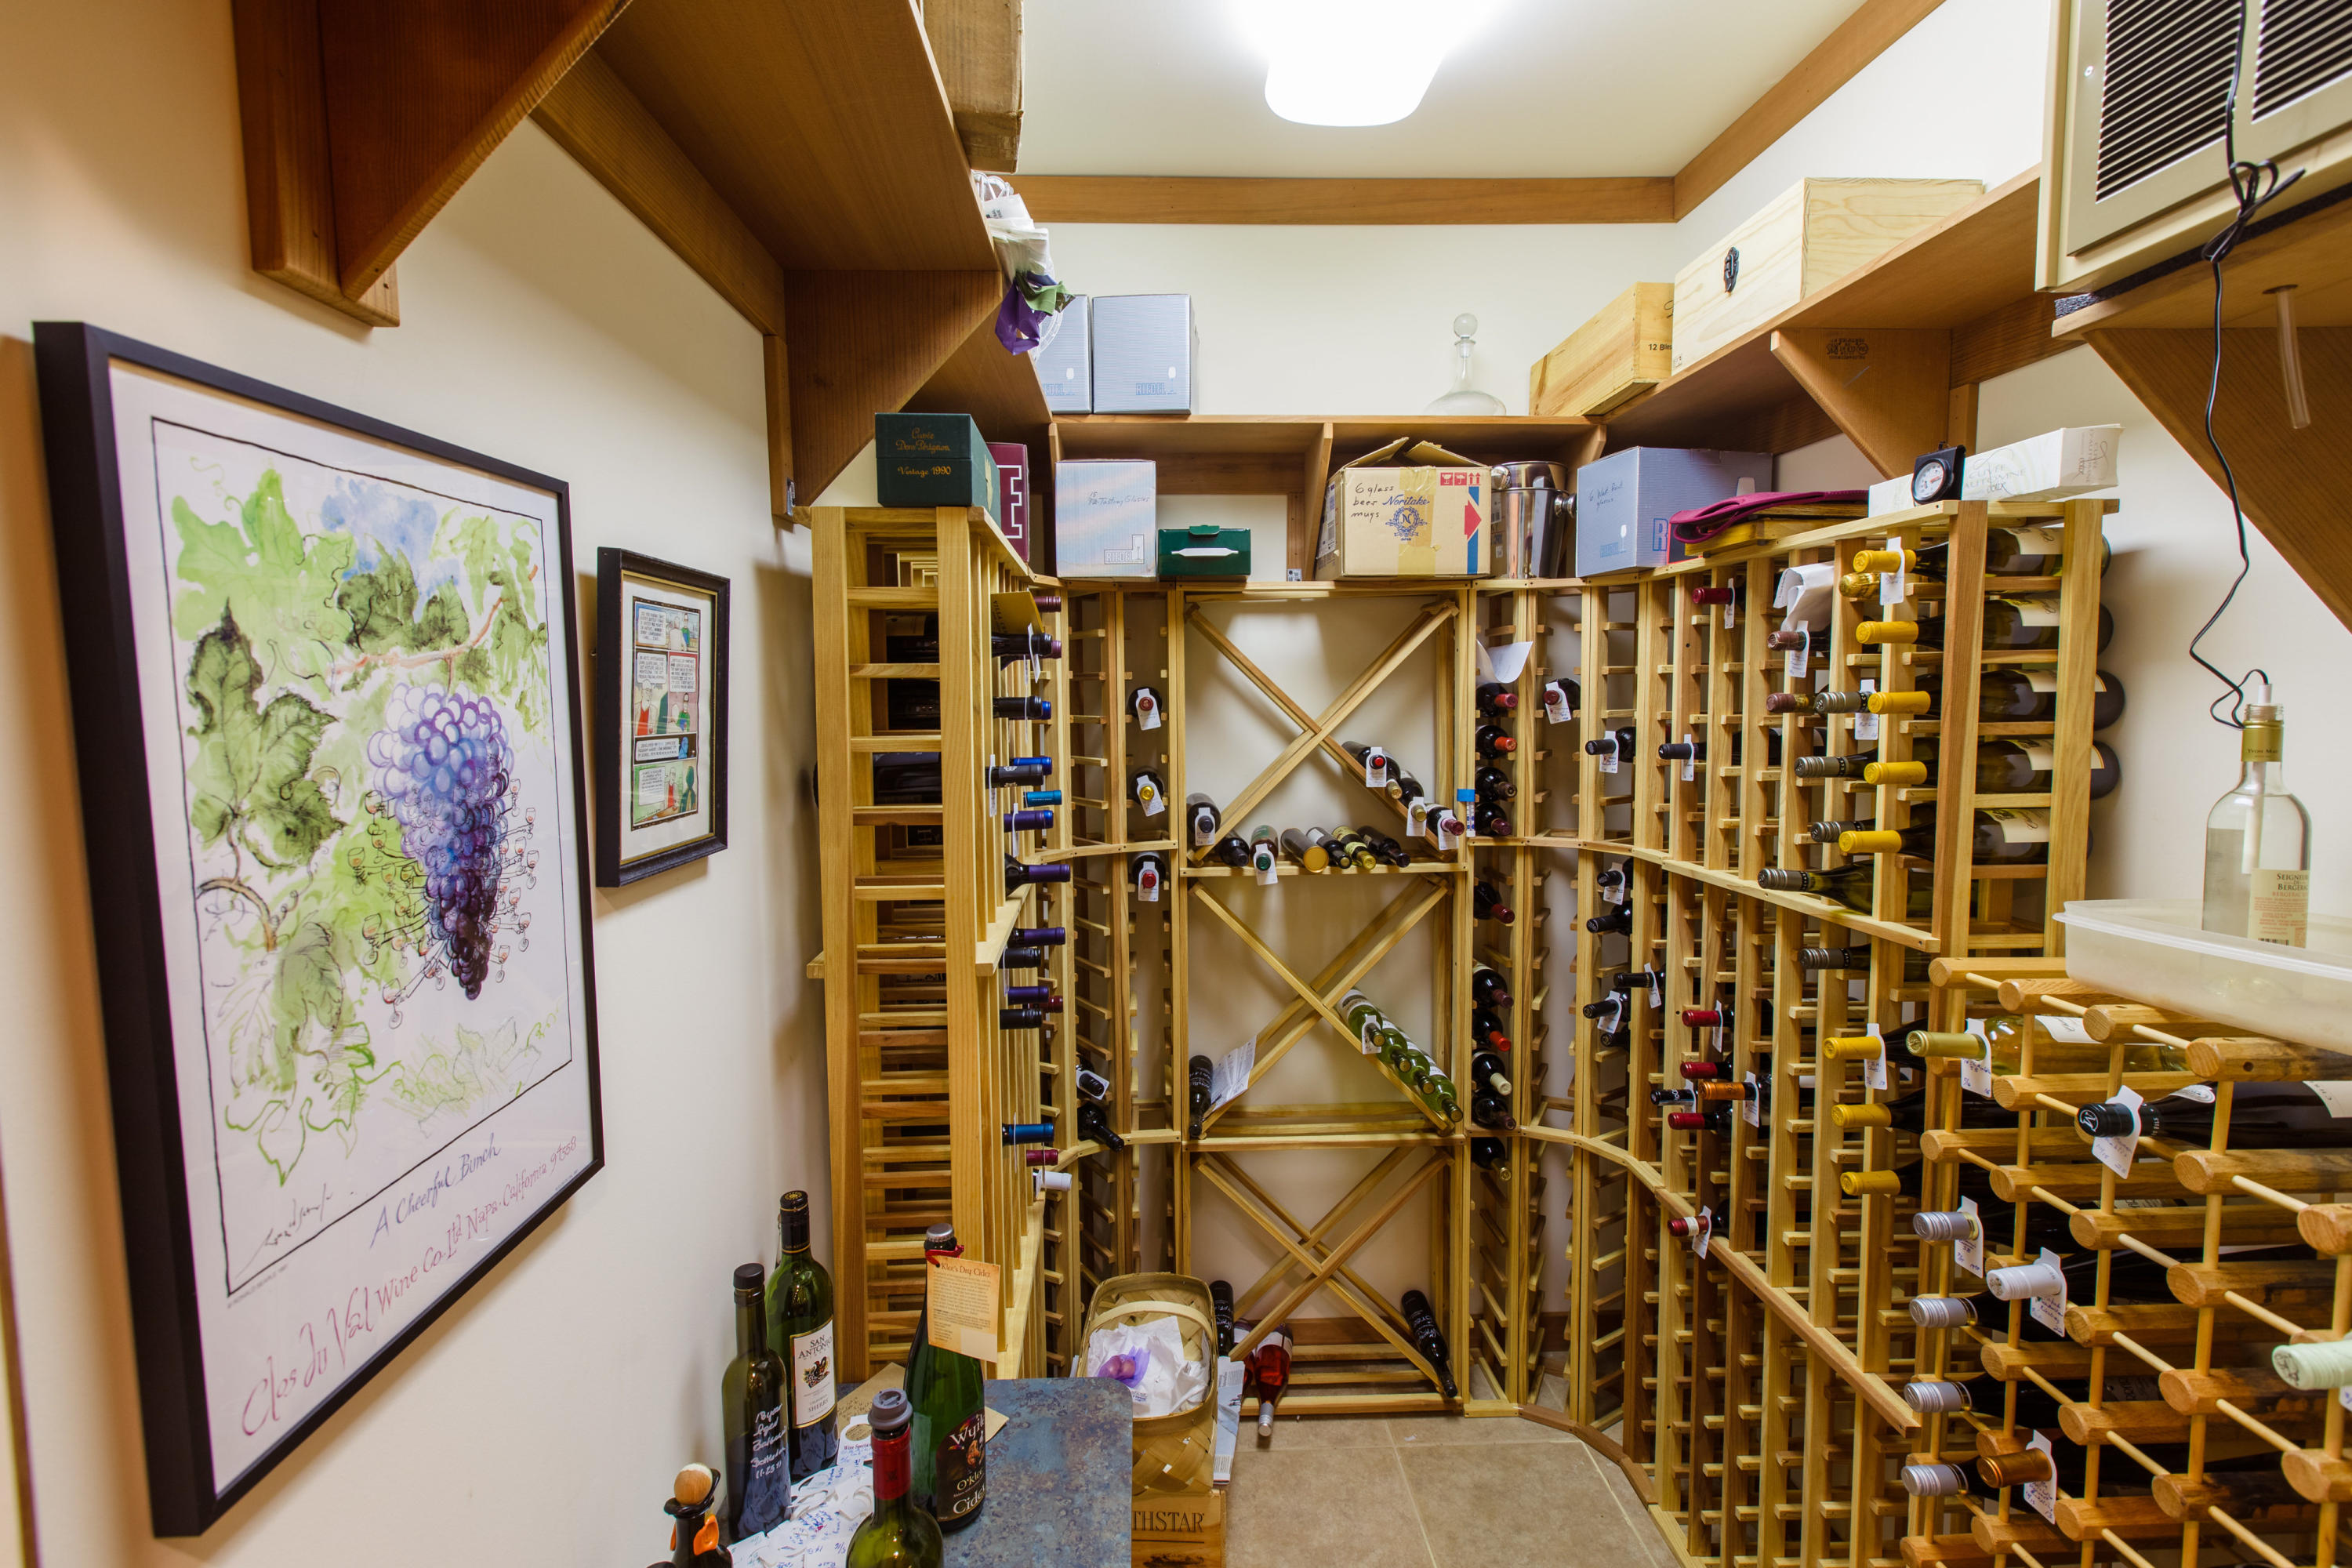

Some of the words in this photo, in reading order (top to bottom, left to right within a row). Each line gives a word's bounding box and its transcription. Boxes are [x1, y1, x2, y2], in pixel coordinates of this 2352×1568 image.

[1135, 382, 1167, 396] RIEDEL
[895, 440, 916, 452] Dom
[897, 466, 929, 478] Vintage
[931, 466, 952, 475] 1990
[1355, 482, 1364, 493] 6
[1367, 484, 1395, 498] glass
[1353, 496, 1377, 506] beer
[1382, 494, 1430, 506] Noritake
[1350, 511, 1380, 524] mugs
[369, 1205, 389, 1249] A
[396, 1165, 453, 1225] Cheerful
[457, 1132, 502, 1183] Bunch
[973, 1268, 990, 1278] Cider
[798, 1335, 833, 1359] ANTONIO
[810, 1334, 826, 1348] SAN
[241, 1356, 297, 1436] Clos
[326, 1287, 375, 1370] Val
[376, 1265, 419, 1316] Wine
